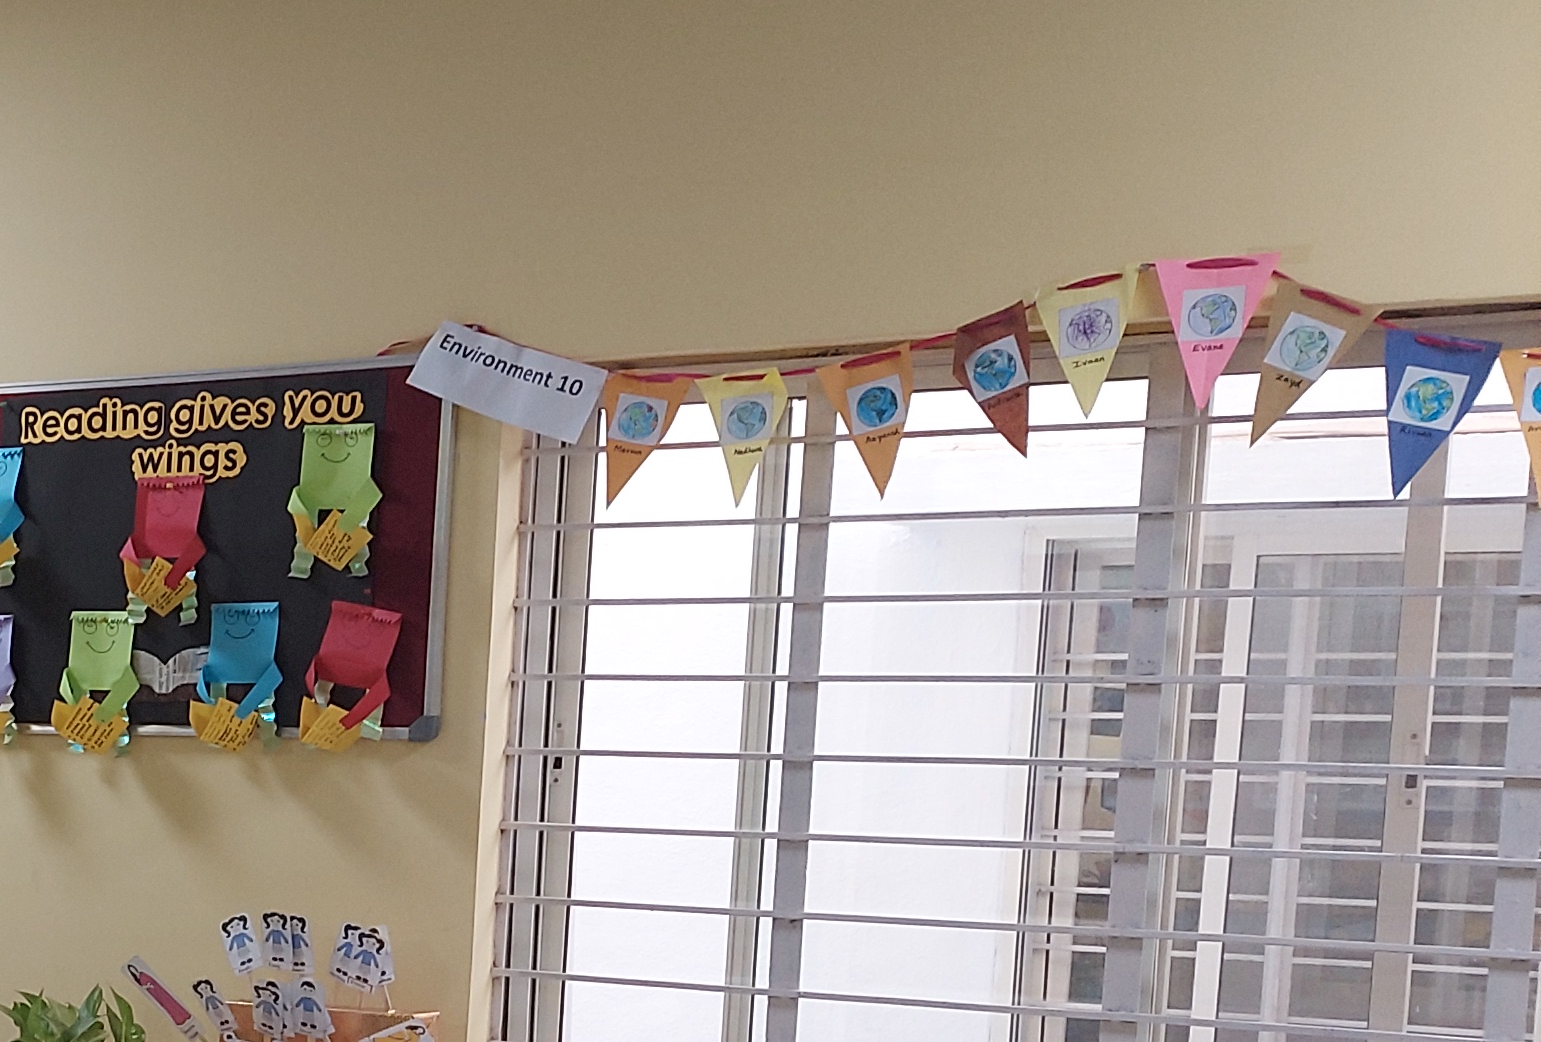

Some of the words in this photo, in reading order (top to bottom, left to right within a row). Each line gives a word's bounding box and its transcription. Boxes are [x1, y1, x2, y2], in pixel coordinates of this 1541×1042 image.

[439, 334, 553, 388] Environment
[556, 375, 584, 396] 10
[21, 398, 164, 442] Reading
[172, 393, 272, 437] gives
[284, 392, 363, 429] you
[136, 441, 243, 482] wings
